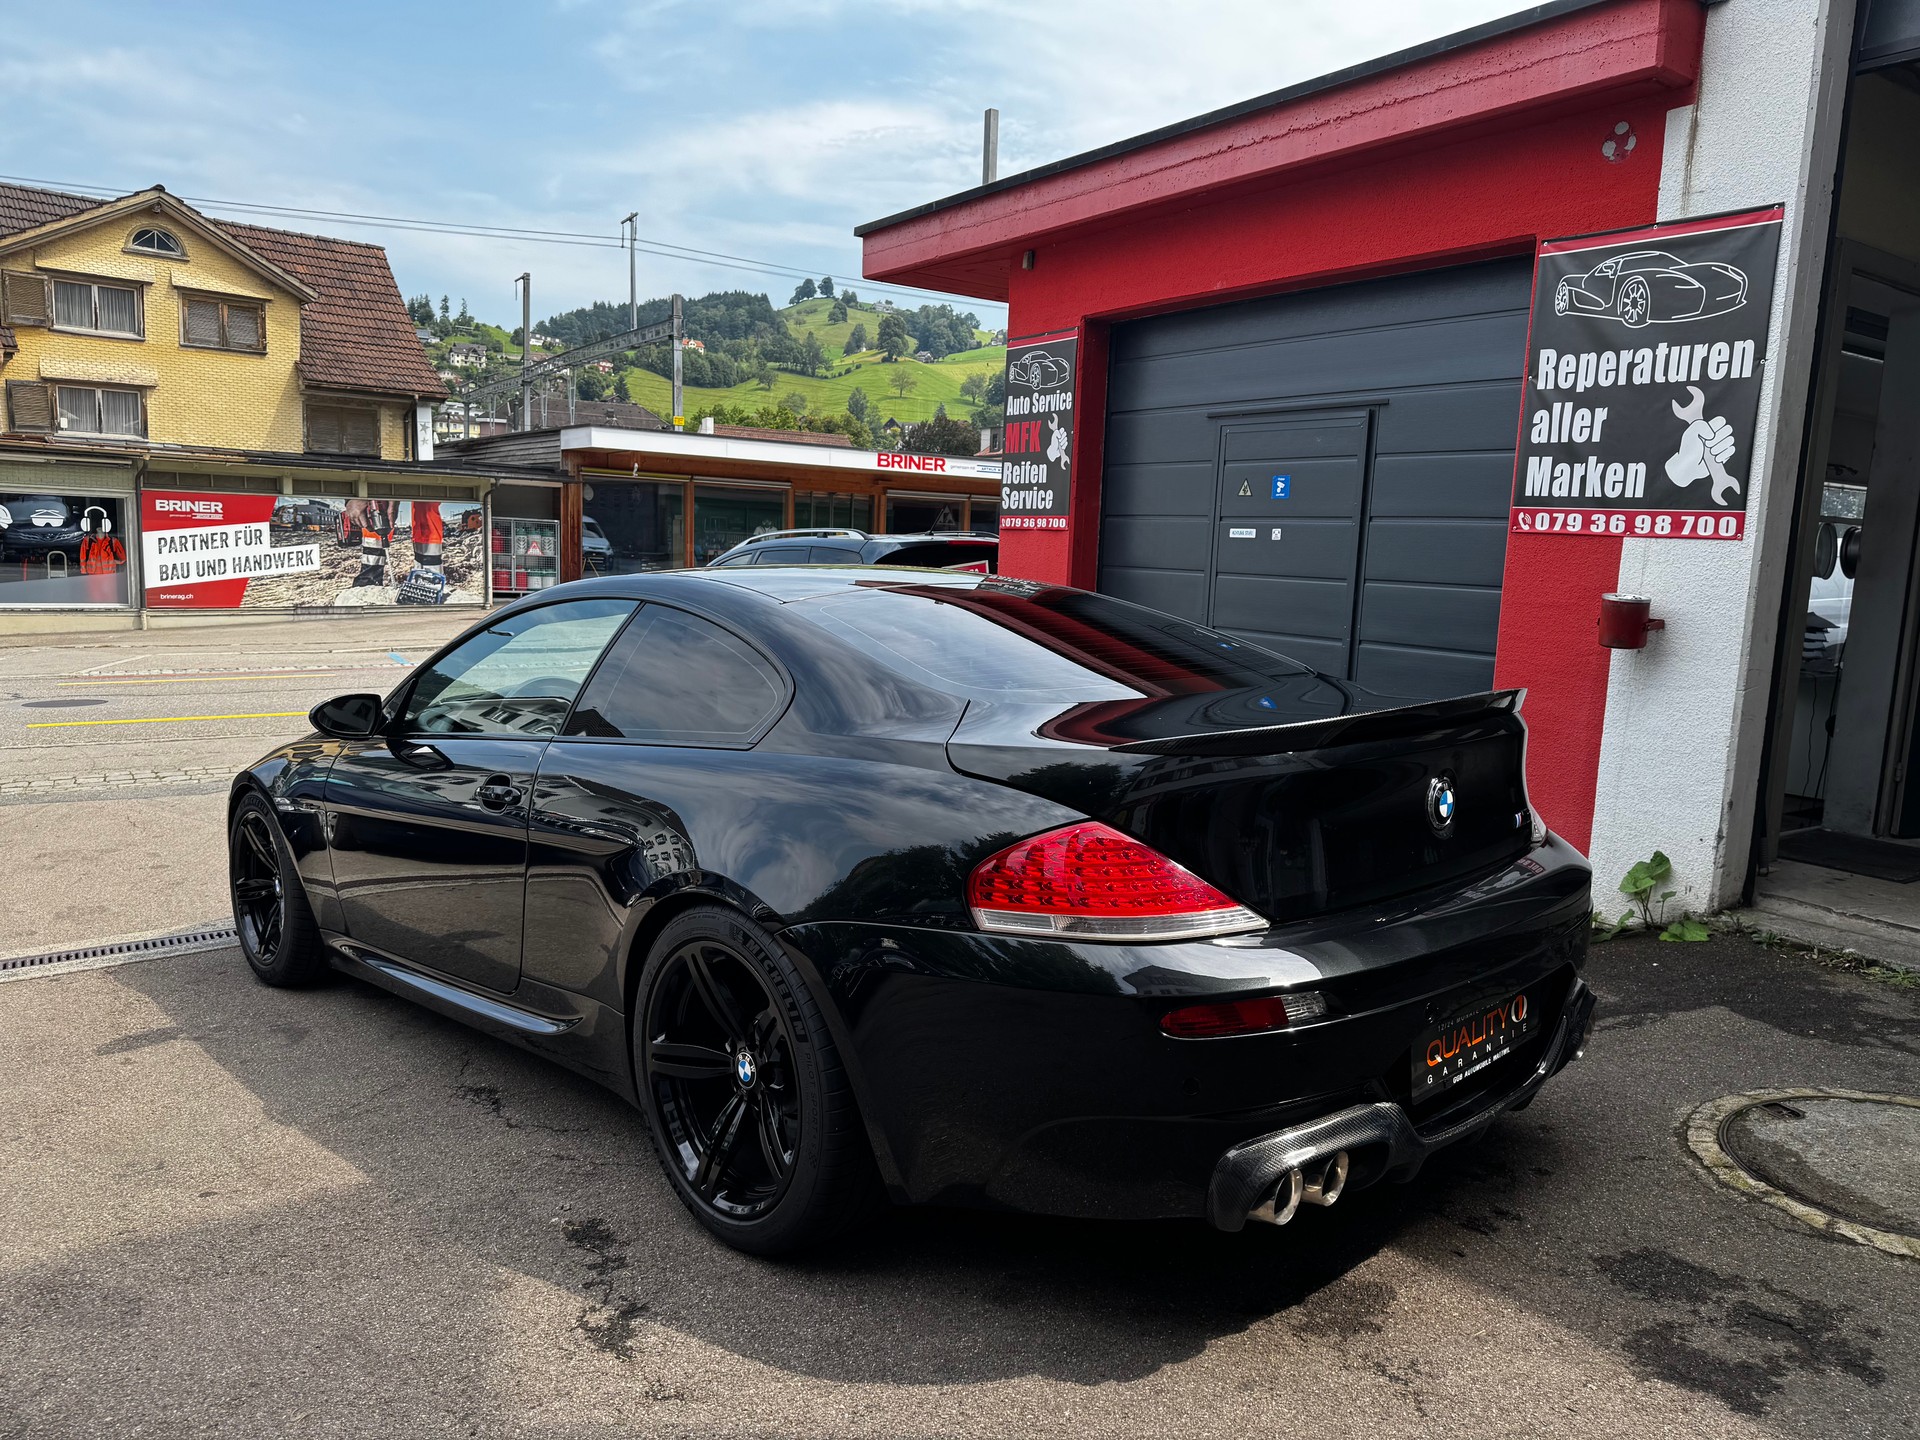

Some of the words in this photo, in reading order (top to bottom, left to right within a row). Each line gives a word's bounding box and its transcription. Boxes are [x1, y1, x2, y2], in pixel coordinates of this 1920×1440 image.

[1536, 339, 1755, 392] Reperaturen
[1006, 394, 1030, 416] Auto
[1032, 390, 1072, 414] Service
[1005, 420, 1042, 454] MFK
[1530, 402, 1608, 444] aller
[877, 453, 947, 472] BRINER
[1002, 461, 1047, 484] Reifen
[1524, 456, 1647, 498] Marken
[155, 499, 224, 514] BRINER
[1001, 486, 1054, 510] Service
[1005, 517, 1021, 528] 079
[1023, 518, 1035, 528] 36
[1037, 518, 1047, 528] 98
[1048, 518, 1066, 528] 700
[1534, 512, 1583, 532] 079
[1589, 514, 1626, 534] 36
[1633, 514, 1672, 535] 98
[1680, 515, 1738, 537] 700
[157, 530, 229, 555] PARTNER
[234, 525, 263, 547] FÜR
[159, 561, 190, 582] BAU
[195, 558, 227, 578] UND
[232, 549, 315, 574] HANDWERK
[160, 592, 194, 601] brinerag.ch
[745, 937, 808, 1036] MICHELIN
[1427, 1022, 1528, 1085] GARANTIE
